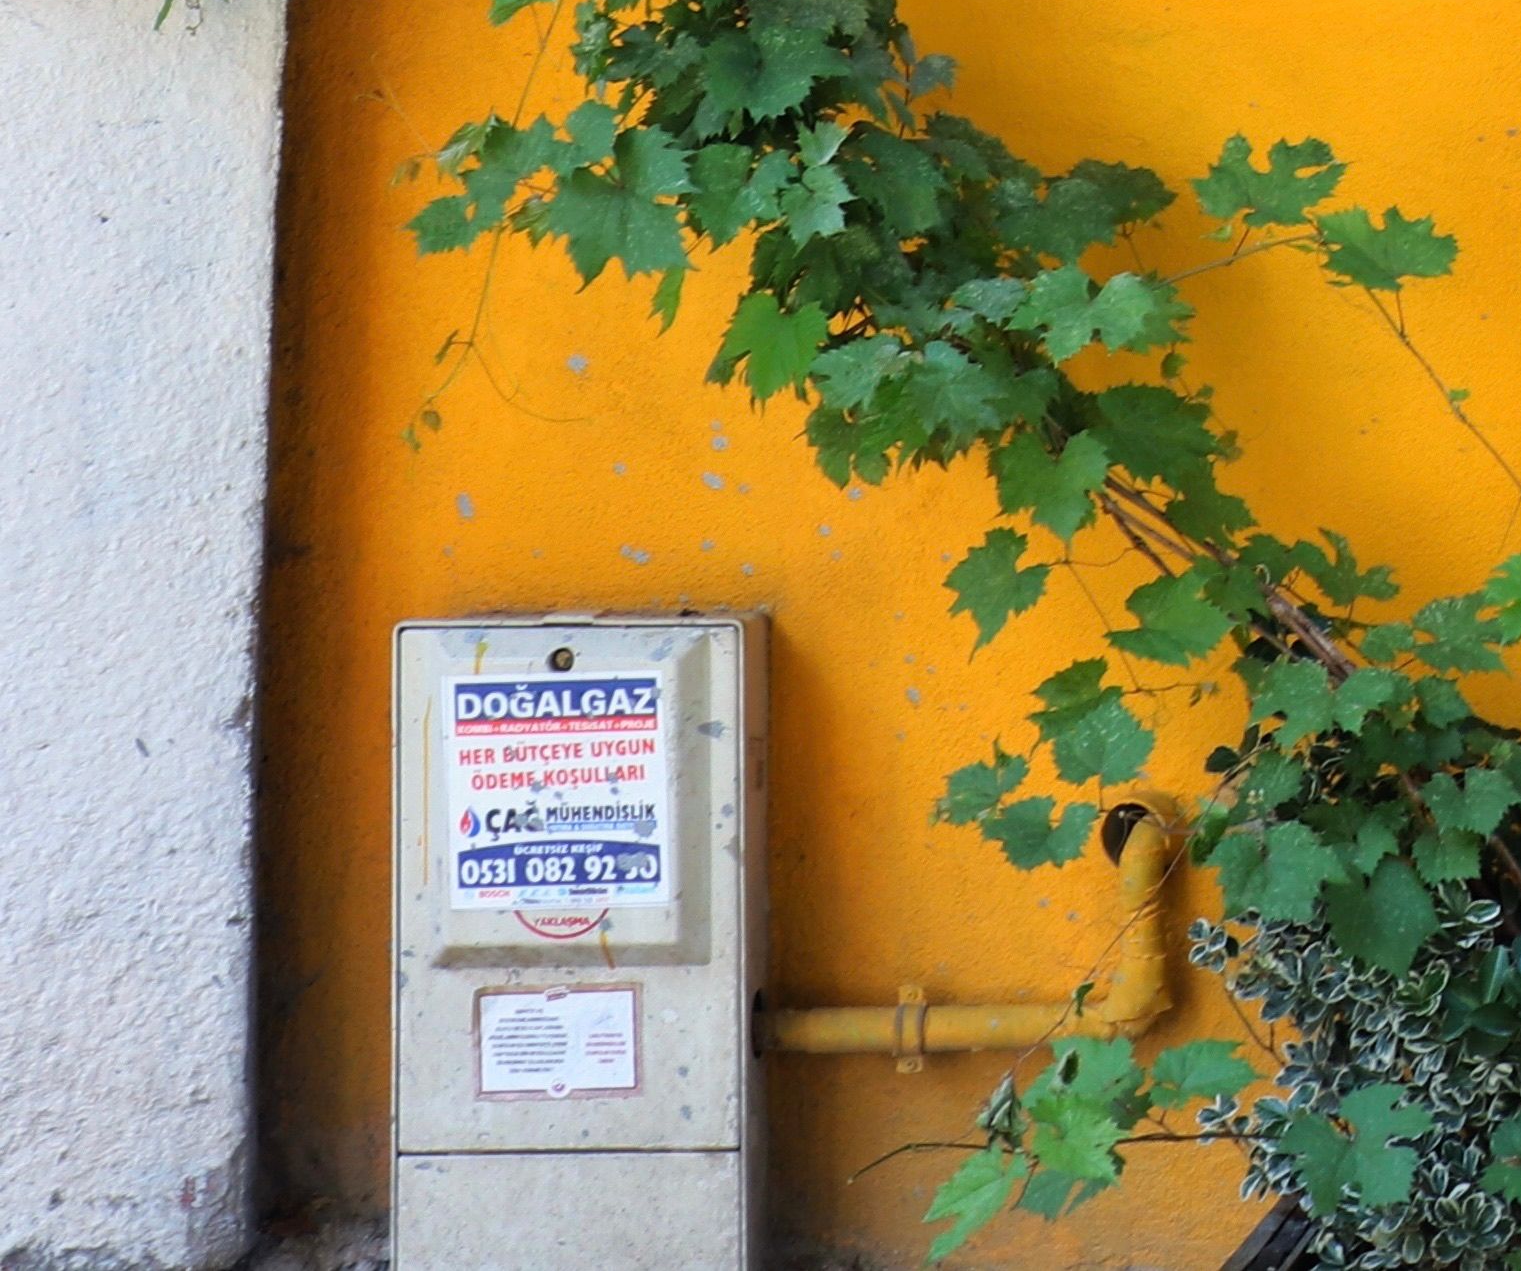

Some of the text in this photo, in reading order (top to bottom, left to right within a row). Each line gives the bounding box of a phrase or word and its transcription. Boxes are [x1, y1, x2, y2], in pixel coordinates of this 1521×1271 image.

[457, 683, 656, 720] DOĞALGAZ
[459, 738, 655, 766] HER BÜTÇEYE UYGUN
[471, 764, 645, 790] ÖDEME KOŞULLARI
[545, 799, 656, 821] MÜHENDİSLİK
[461, 858, 516, 885] 0531
[525, 856, 578, 883] 082
[584, 854, 617, 881] 92
